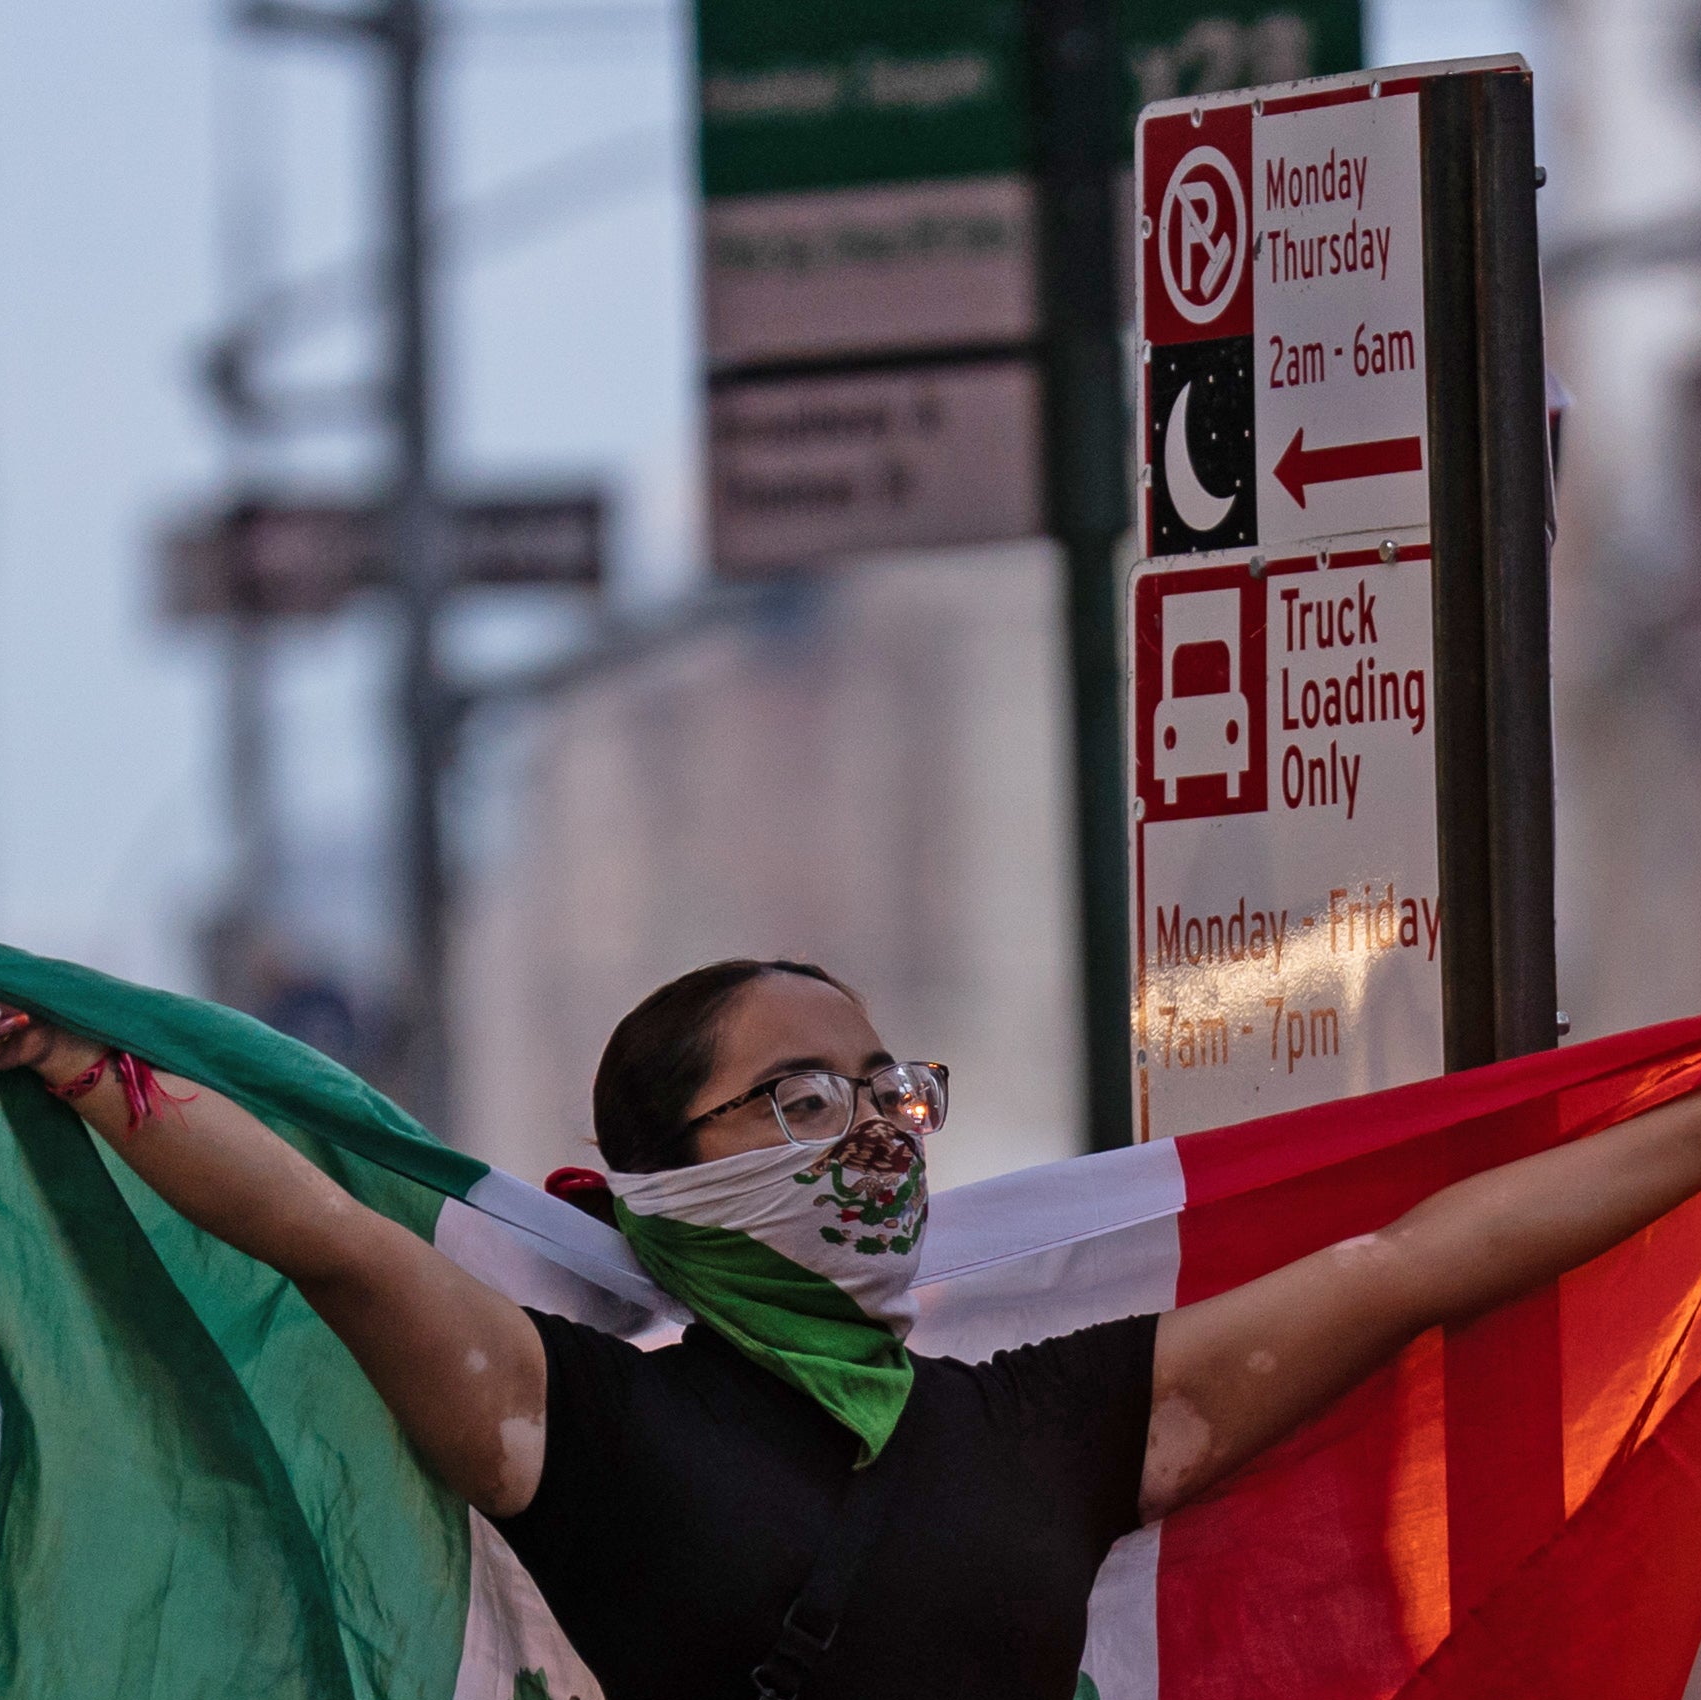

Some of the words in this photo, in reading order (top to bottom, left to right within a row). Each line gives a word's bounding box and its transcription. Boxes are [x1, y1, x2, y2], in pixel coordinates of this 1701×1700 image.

[1266, 148, 1368, 211] Monday
[1267, 218, 1391, 283] Thursday
[1269, 335, 1325, 389] 2am
[1354, 322, 1415, 376] 6am
[1280, 580, 1377, 652] Truck
[1282, 658, 1426, 735] Loading
[1282, 741, 1360, 820] Only
[1157, 905, 1288, 972] Monday
[1329, 882, 1441, 962] Friday
[1160, 1005, 1228, 1070] 7am
[1265, 997, 1339, 1074] 7pm
